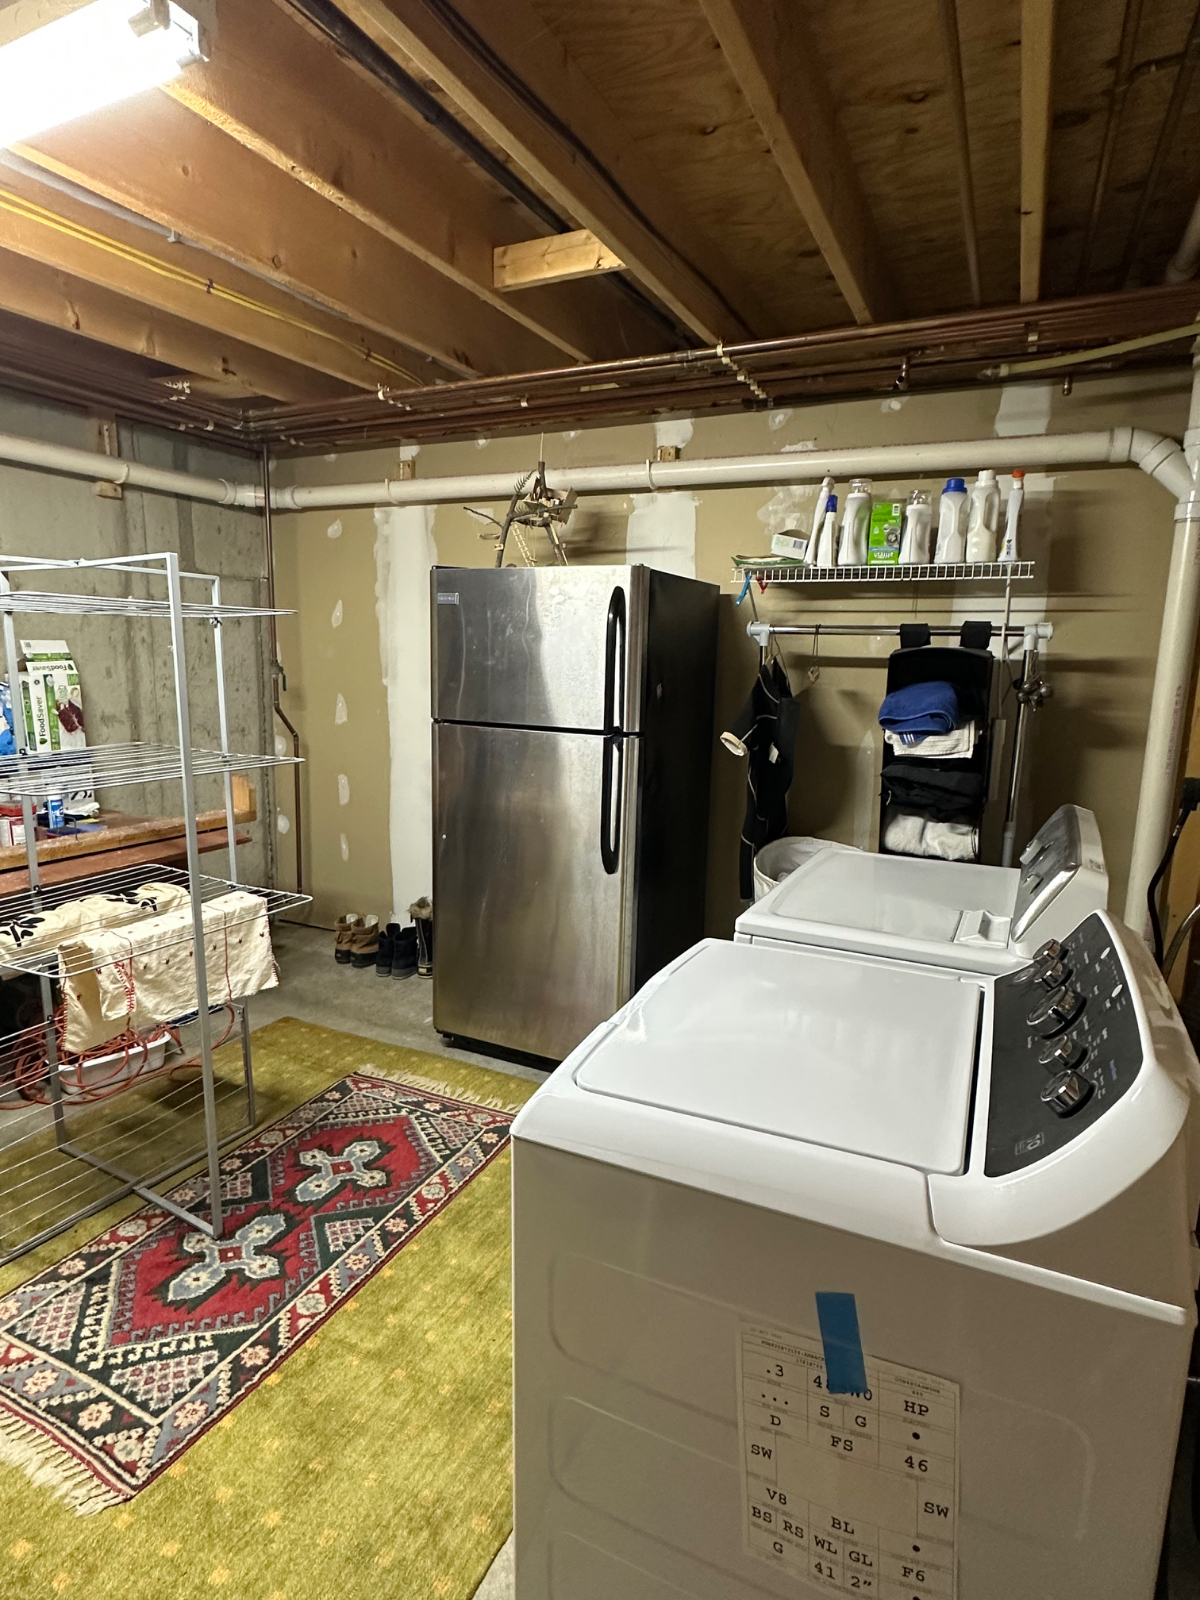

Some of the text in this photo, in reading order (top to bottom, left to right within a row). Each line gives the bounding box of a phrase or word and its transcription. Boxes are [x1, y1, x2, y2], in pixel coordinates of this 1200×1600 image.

[36, 697, 46, 737] FoodSaver
[819, 1405, 831, 1418] S
[904, 1400, 929, 1417] HP
[770, 1415, 782, 1427] D
[855, 1415, 867, 1428] G
[751, 1444, 773, 1460] SW
[831, 1435, 854, 1452] FS
[904, 1456, 928, 1473] 46
[766, 1488, 788, 1505] V8
[752, 1506, 772, 1523] BS
[924, 1502, 950, 1518] SW
[783, 1520, 804, 1539] RS
[831, 1516, 855, 1535] BL
[773, 1542, 784, 1554] G
[814, 1535, 838, 1554] WL
[849, 1551, 873, 1567] GL
[814, 1562, 836, 1580] 41
[902, 1566, 926, 1582] F6
